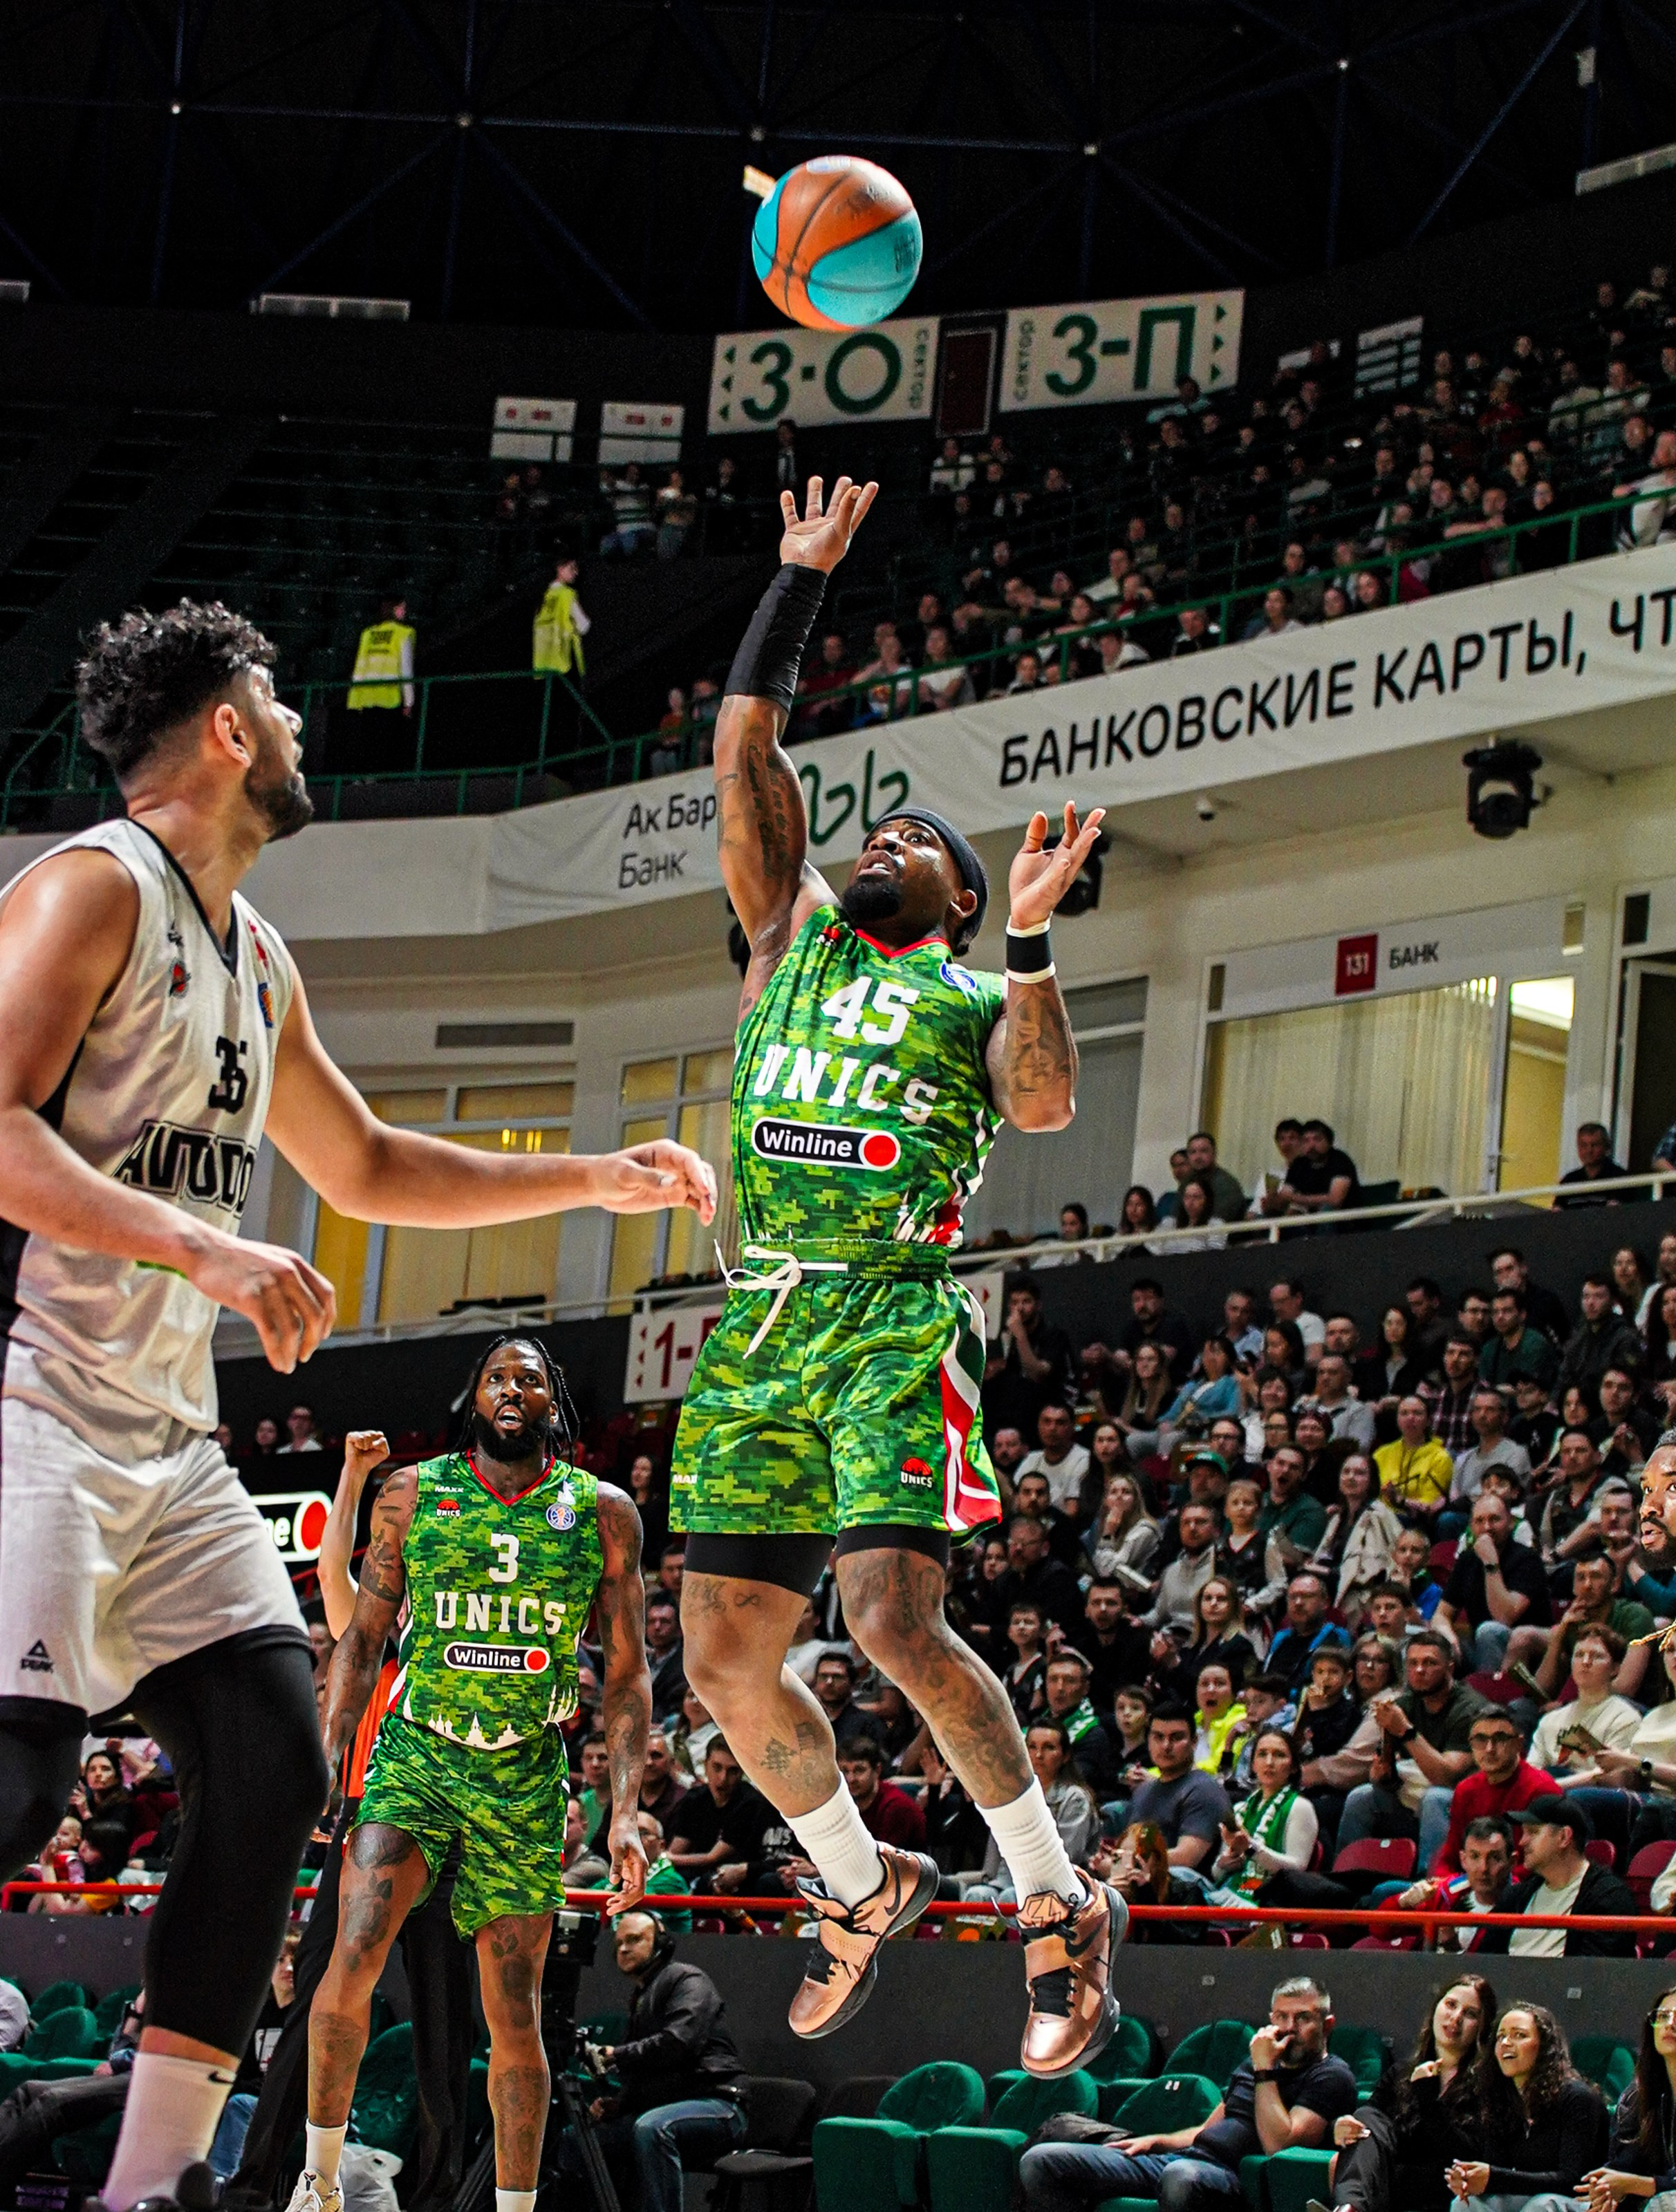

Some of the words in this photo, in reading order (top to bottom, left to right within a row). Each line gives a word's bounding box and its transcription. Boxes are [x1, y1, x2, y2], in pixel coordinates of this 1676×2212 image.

[1000, 661, 1357, 787] БАНКОВСКИЕ
[1374, 608, 1586, 709] КАРТЫ,
[623, 801, 662, 839] Ак
[619, 850, 688, 889] Банк
[1389, 941, 1440, 970] БАНК
[821, 976, 920, 1045] 45
[753, 1044, 939, 1125] UNICS
[762, 1126, 853, 1158] Winline
[901, 1471, 933, 1488] UNICS
[436, 1508, 460, 1517] UNICS
[488, 1533, 519, 1583] 3
[434, 1592, 566, 1635] UNICS
[454, 1649, 521, 1668] Winline
